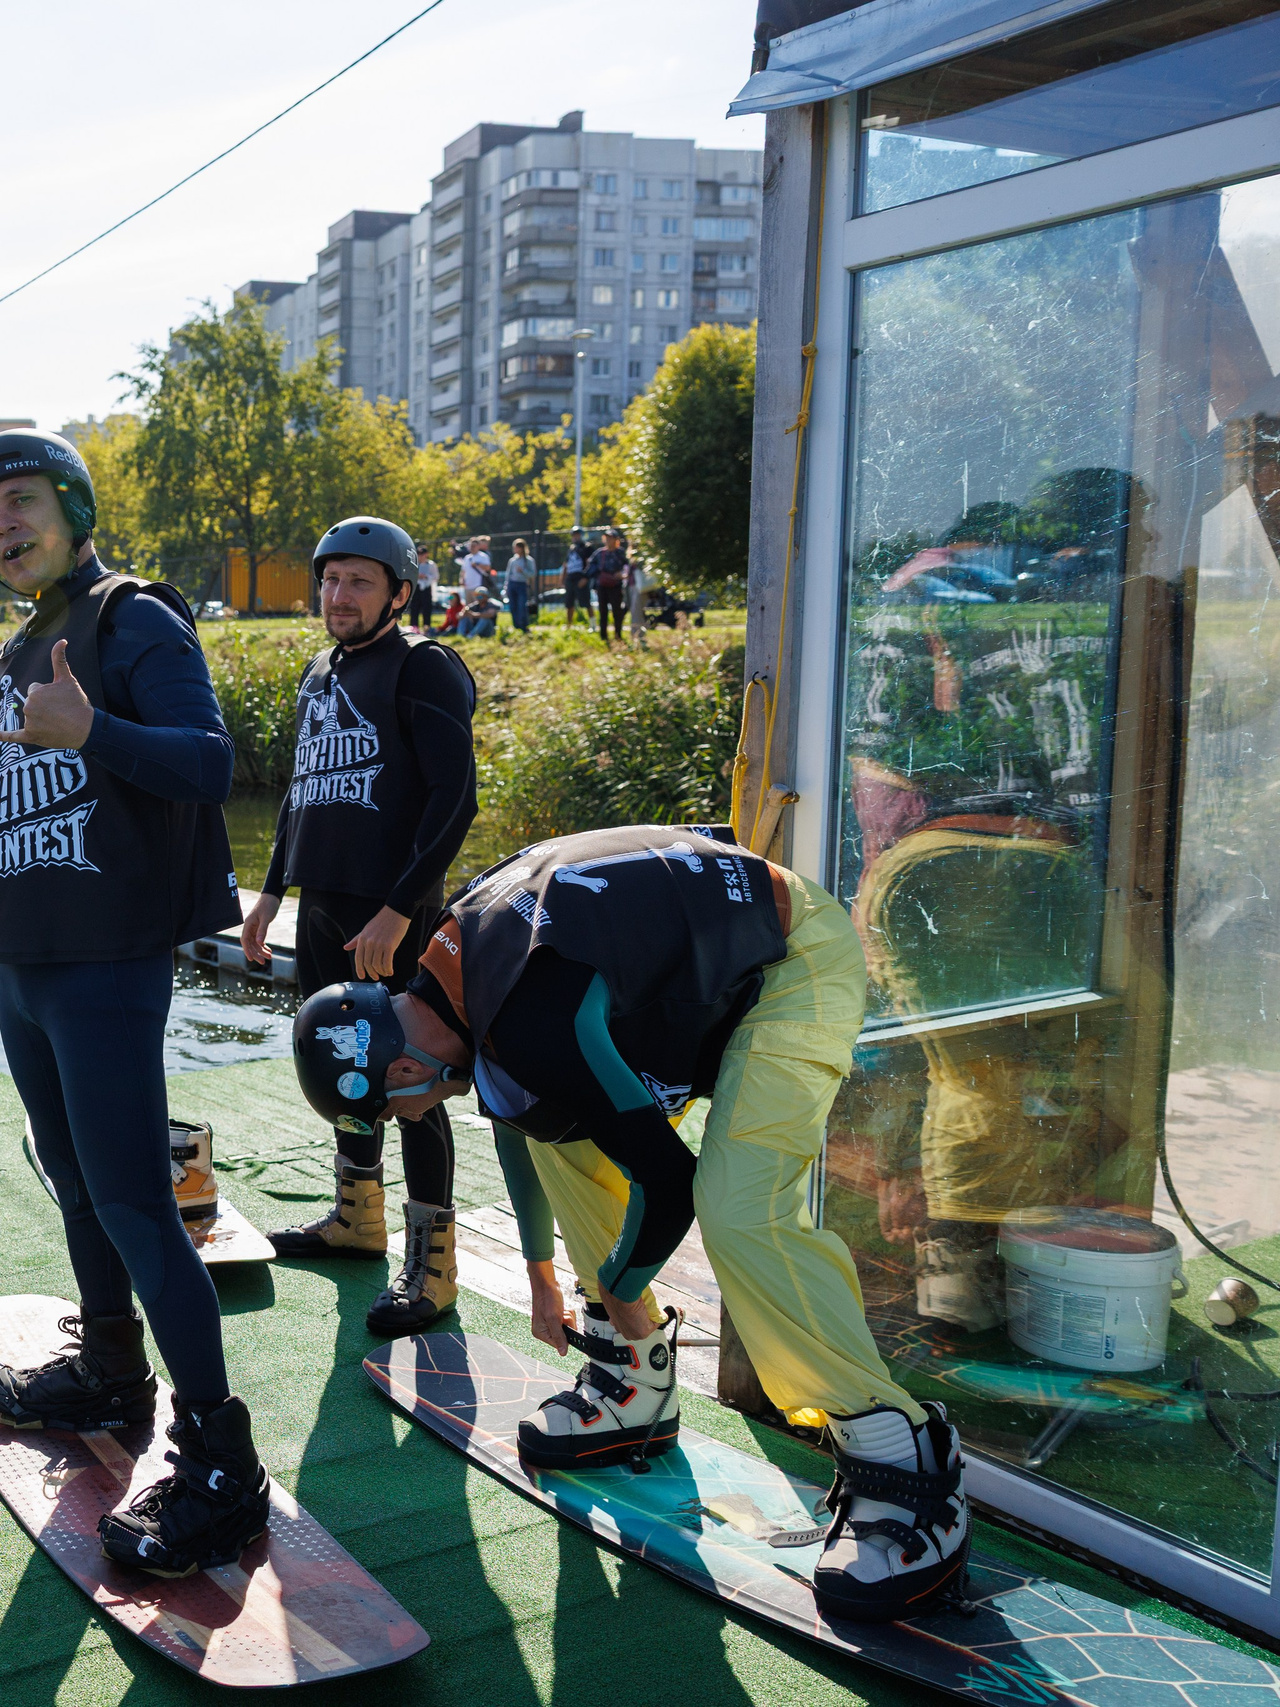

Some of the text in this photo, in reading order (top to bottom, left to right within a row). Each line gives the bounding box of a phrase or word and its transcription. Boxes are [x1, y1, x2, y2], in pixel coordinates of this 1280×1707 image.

[5, 460, 40, 471] MYSTIC
[303, 767, 377, 805] CONTEST
[733, 854, 753, 903] АВТОСЕРВИС
